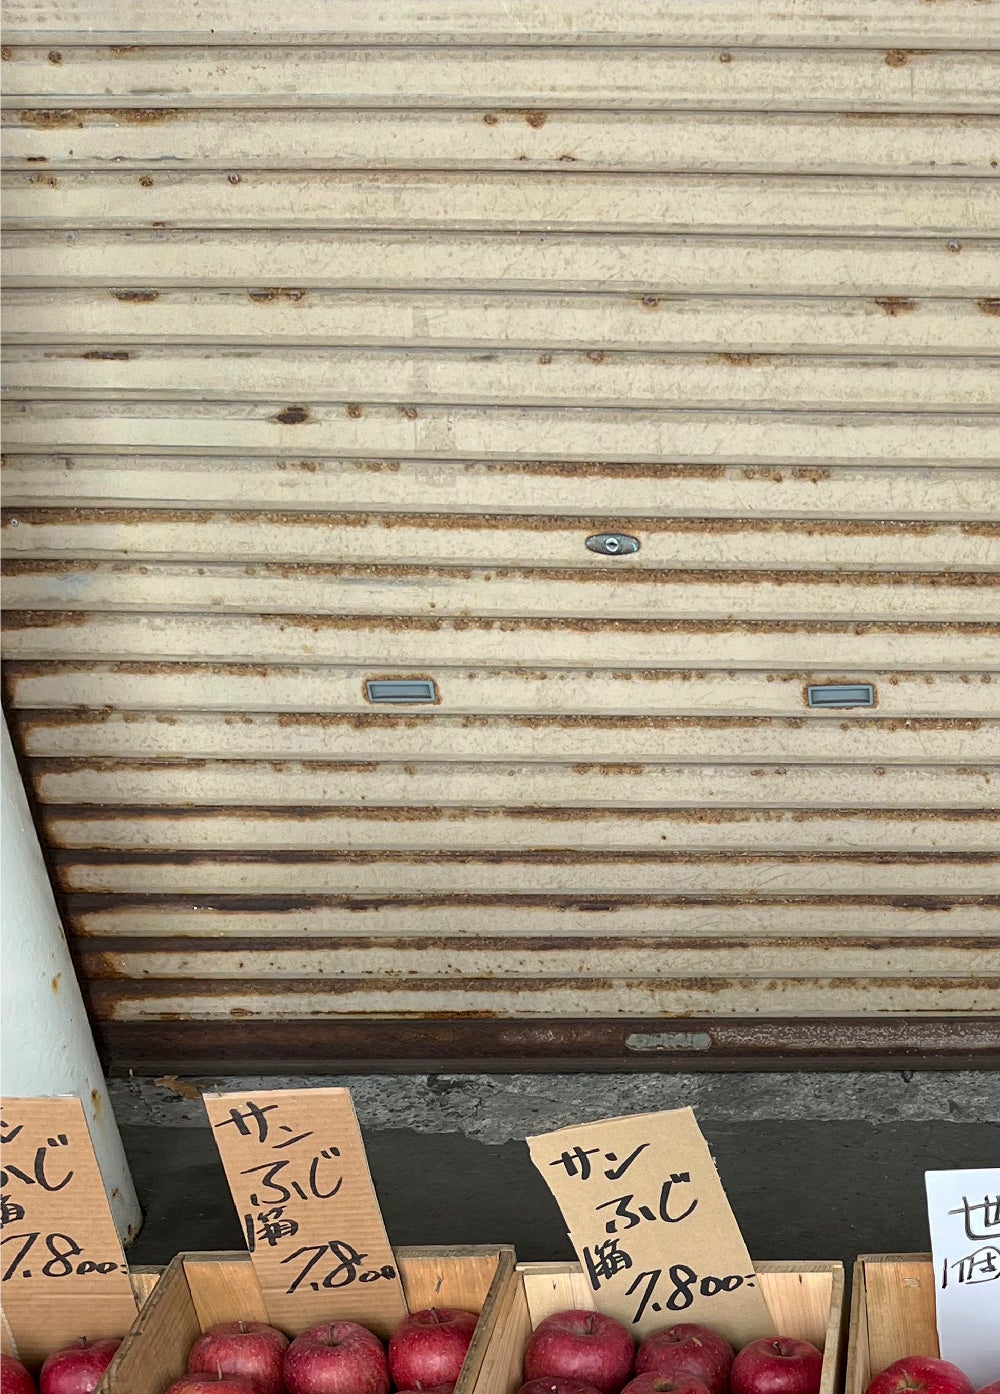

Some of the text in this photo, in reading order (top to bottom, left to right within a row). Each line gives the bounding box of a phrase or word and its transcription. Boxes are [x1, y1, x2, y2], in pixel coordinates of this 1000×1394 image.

[214, 1101, 314, 1149] サン
[239, 1146, 343, 1205] ふじ
[548, 1142, 651, 1180] サン
[595, 1171, 699, 1234] ふじ
